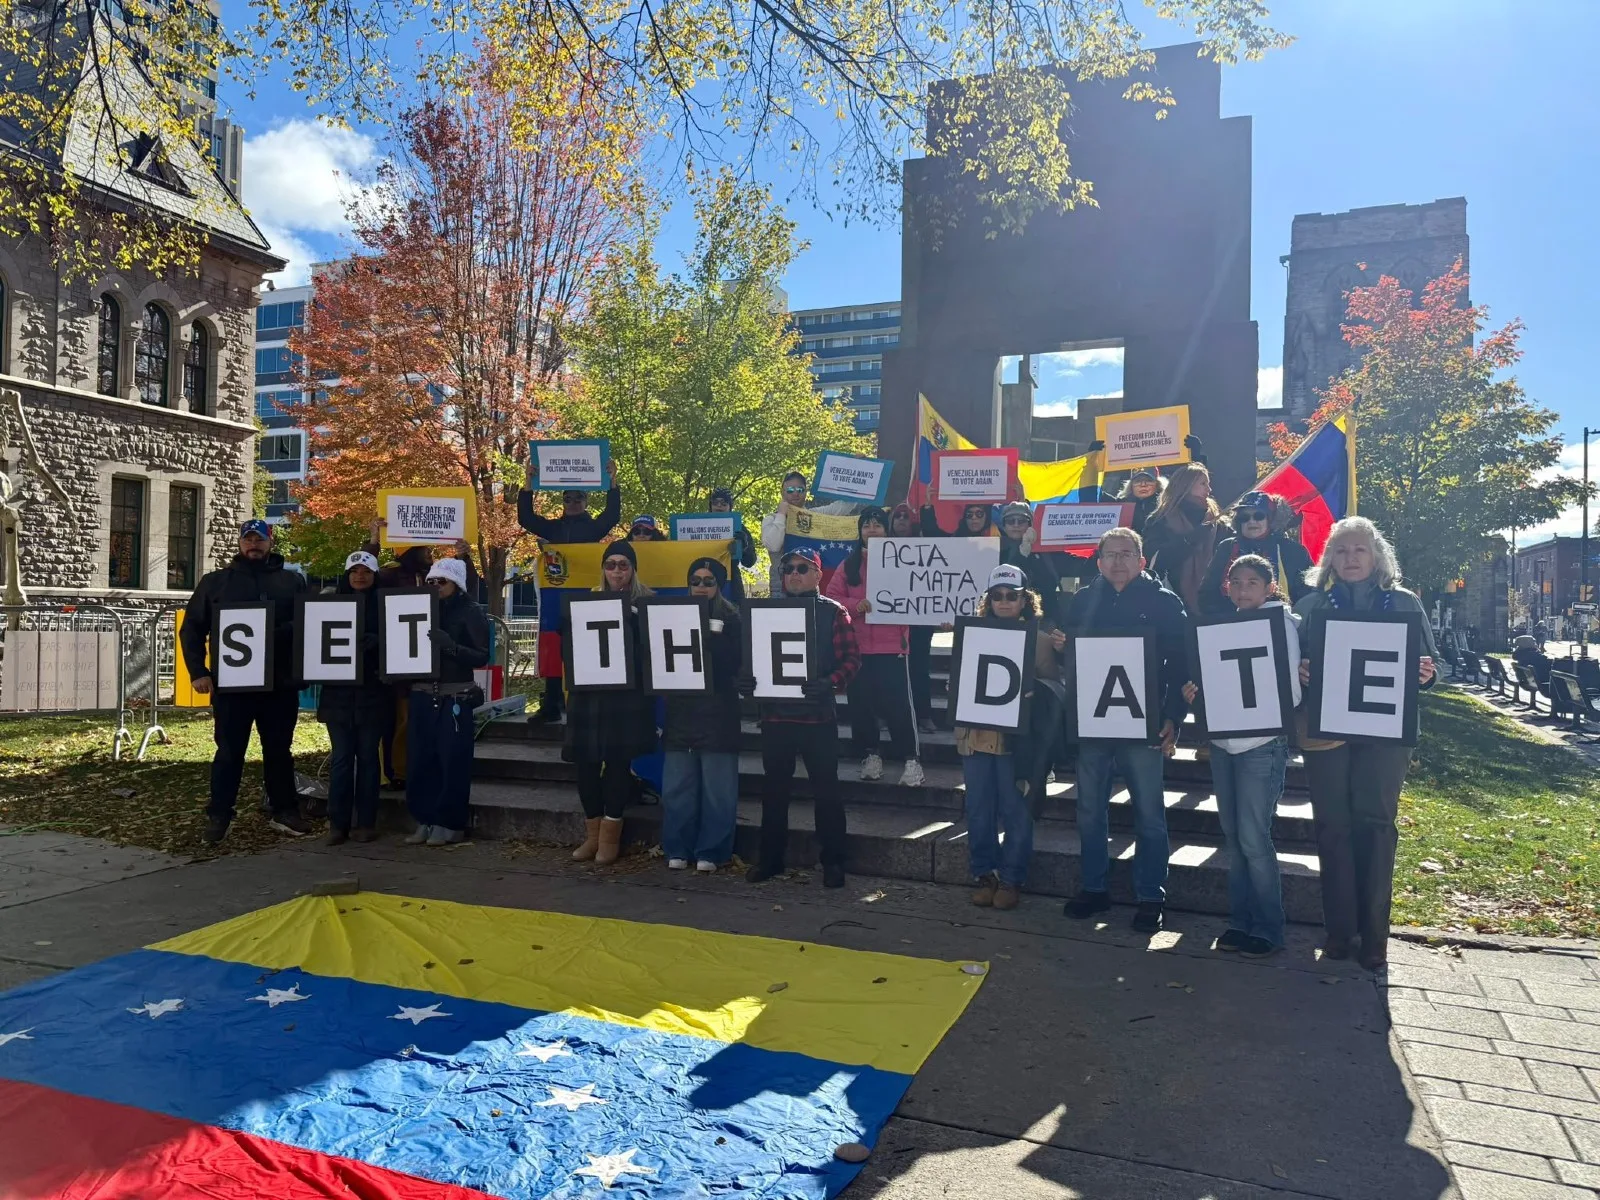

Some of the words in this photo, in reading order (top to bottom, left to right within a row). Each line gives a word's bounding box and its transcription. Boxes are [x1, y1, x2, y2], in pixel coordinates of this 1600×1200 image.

[1118, 433, 1144, 442] FREEDOM
[1145, 431, 1155, 439] FOR
[1156, 430, 1167, 438] ALL
[1114, 441, 1140, 450] POLITICAL
[1141, 438, 1172, 447] PRISONERS
[830, 466, 856, 476] VENEZUELA
[857, 470, 874, 479] WANTS
[947, 469, 978, 477] VENEZUELA
[980, 469, 999, 477] WANTS
[839, 475, 851, 483] VOTE
[397, 504, 409, 513] SET
[411, 505, 424, 513] THE
[425, 506, 442, 514] DATE
[443, 506, 456, 514] FOR
[397, 512, 410, 520] THE
[410, 513, 456, 522] PRESIDENTIAL
[401, 520, 432, 529] ELECTION
[433, 521, 451, 529] NOW!
[882, 540, 949, 569] ACTA
[909, 569, 978, 593] MATA
